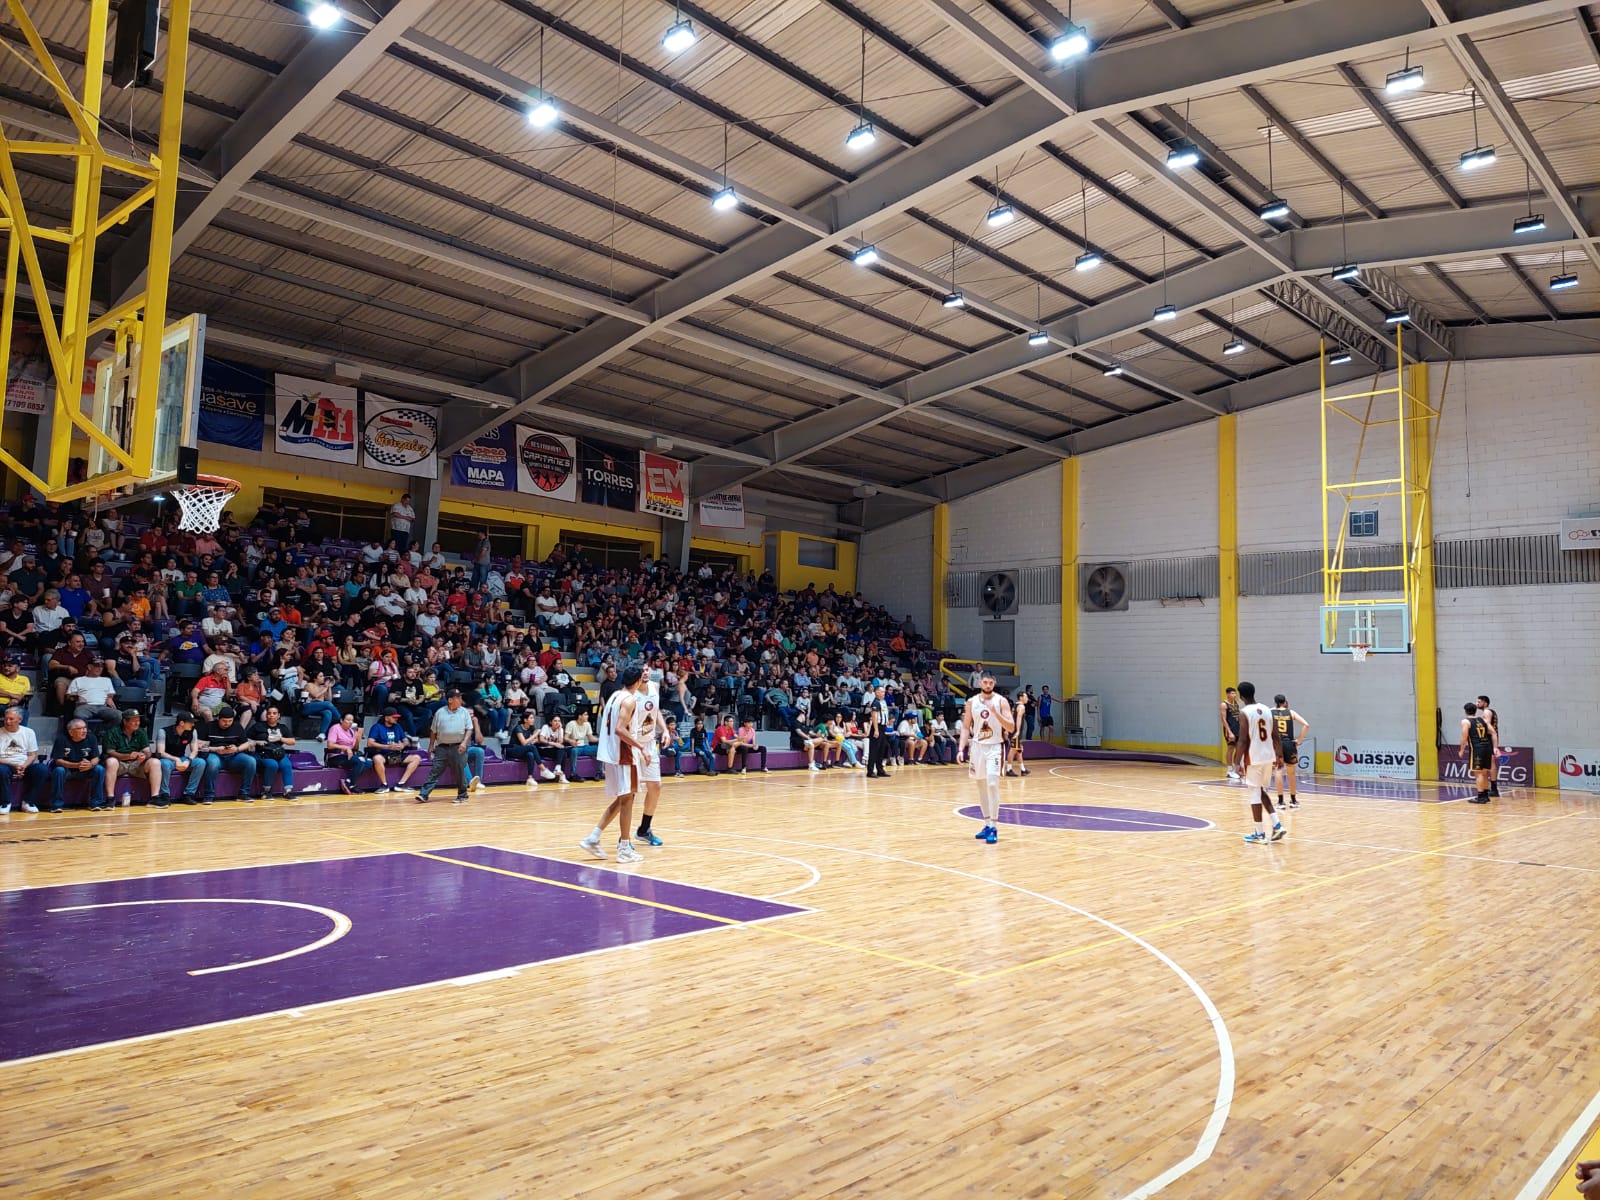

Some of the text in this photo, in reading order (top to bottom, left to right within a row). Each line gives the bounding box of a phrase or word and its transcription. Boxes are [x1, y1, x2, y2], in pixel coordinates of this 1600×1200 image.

[523, 450, 571, 467] CAPITANES
[467, 467, 504, 481] MAPA
[585, 467, 634, 489] TORRES
[1258, 718, 1268, 742] 6
[1277, 720, 1287, 733] 9
[1476, 726, 1486, 739] 17
[1335, 745, 1416, 766] Guasave
